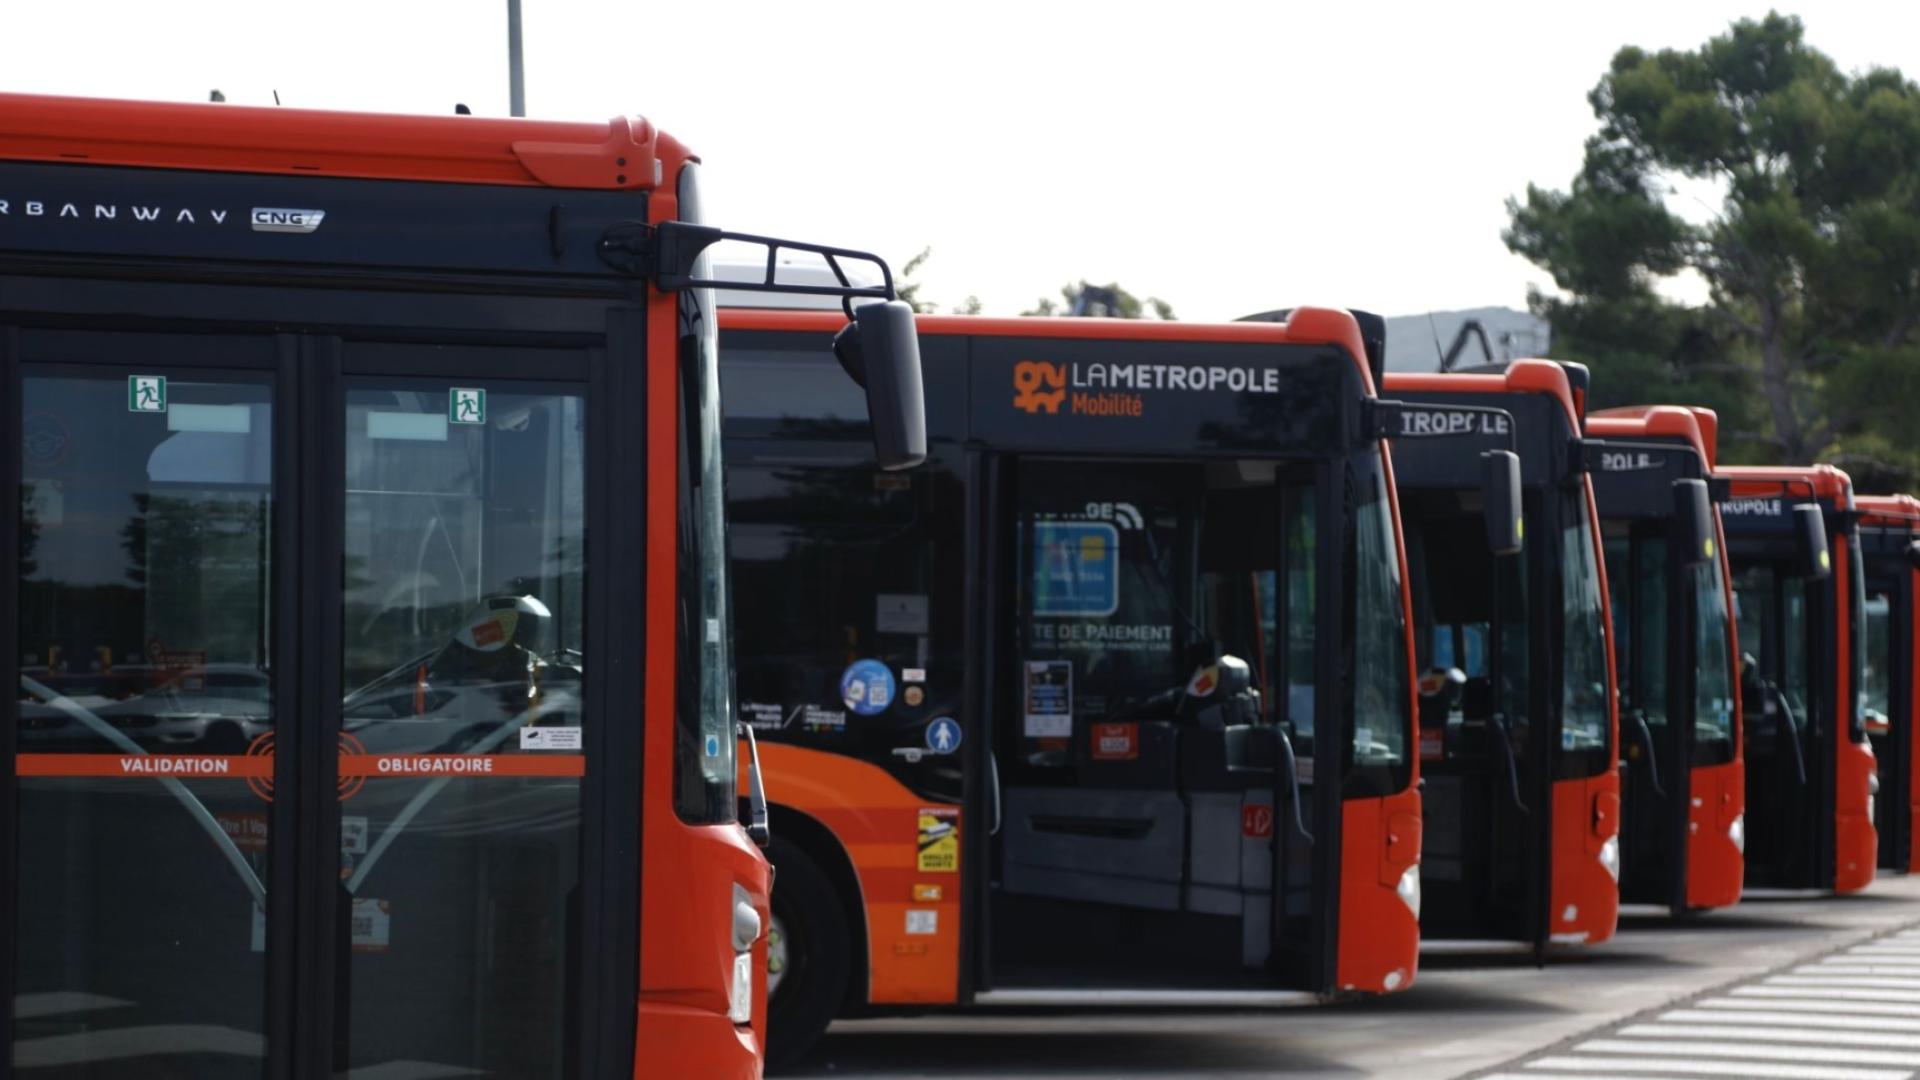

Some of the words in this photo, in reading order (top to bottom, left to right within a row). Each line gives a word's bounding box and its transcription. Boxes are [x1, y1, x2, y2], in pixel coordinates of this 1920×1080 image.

[254, 211, 305, 225] CNG
[1072, 392, 1143, 416] Mobilité
[1058, 624, 1081, 640] DE
[1086, 624, 1173, 641] PAIEMENT
[121, 758, 228, 773] VALIDATION
[378, 758, 492, 772] OBLIGATOIRE
